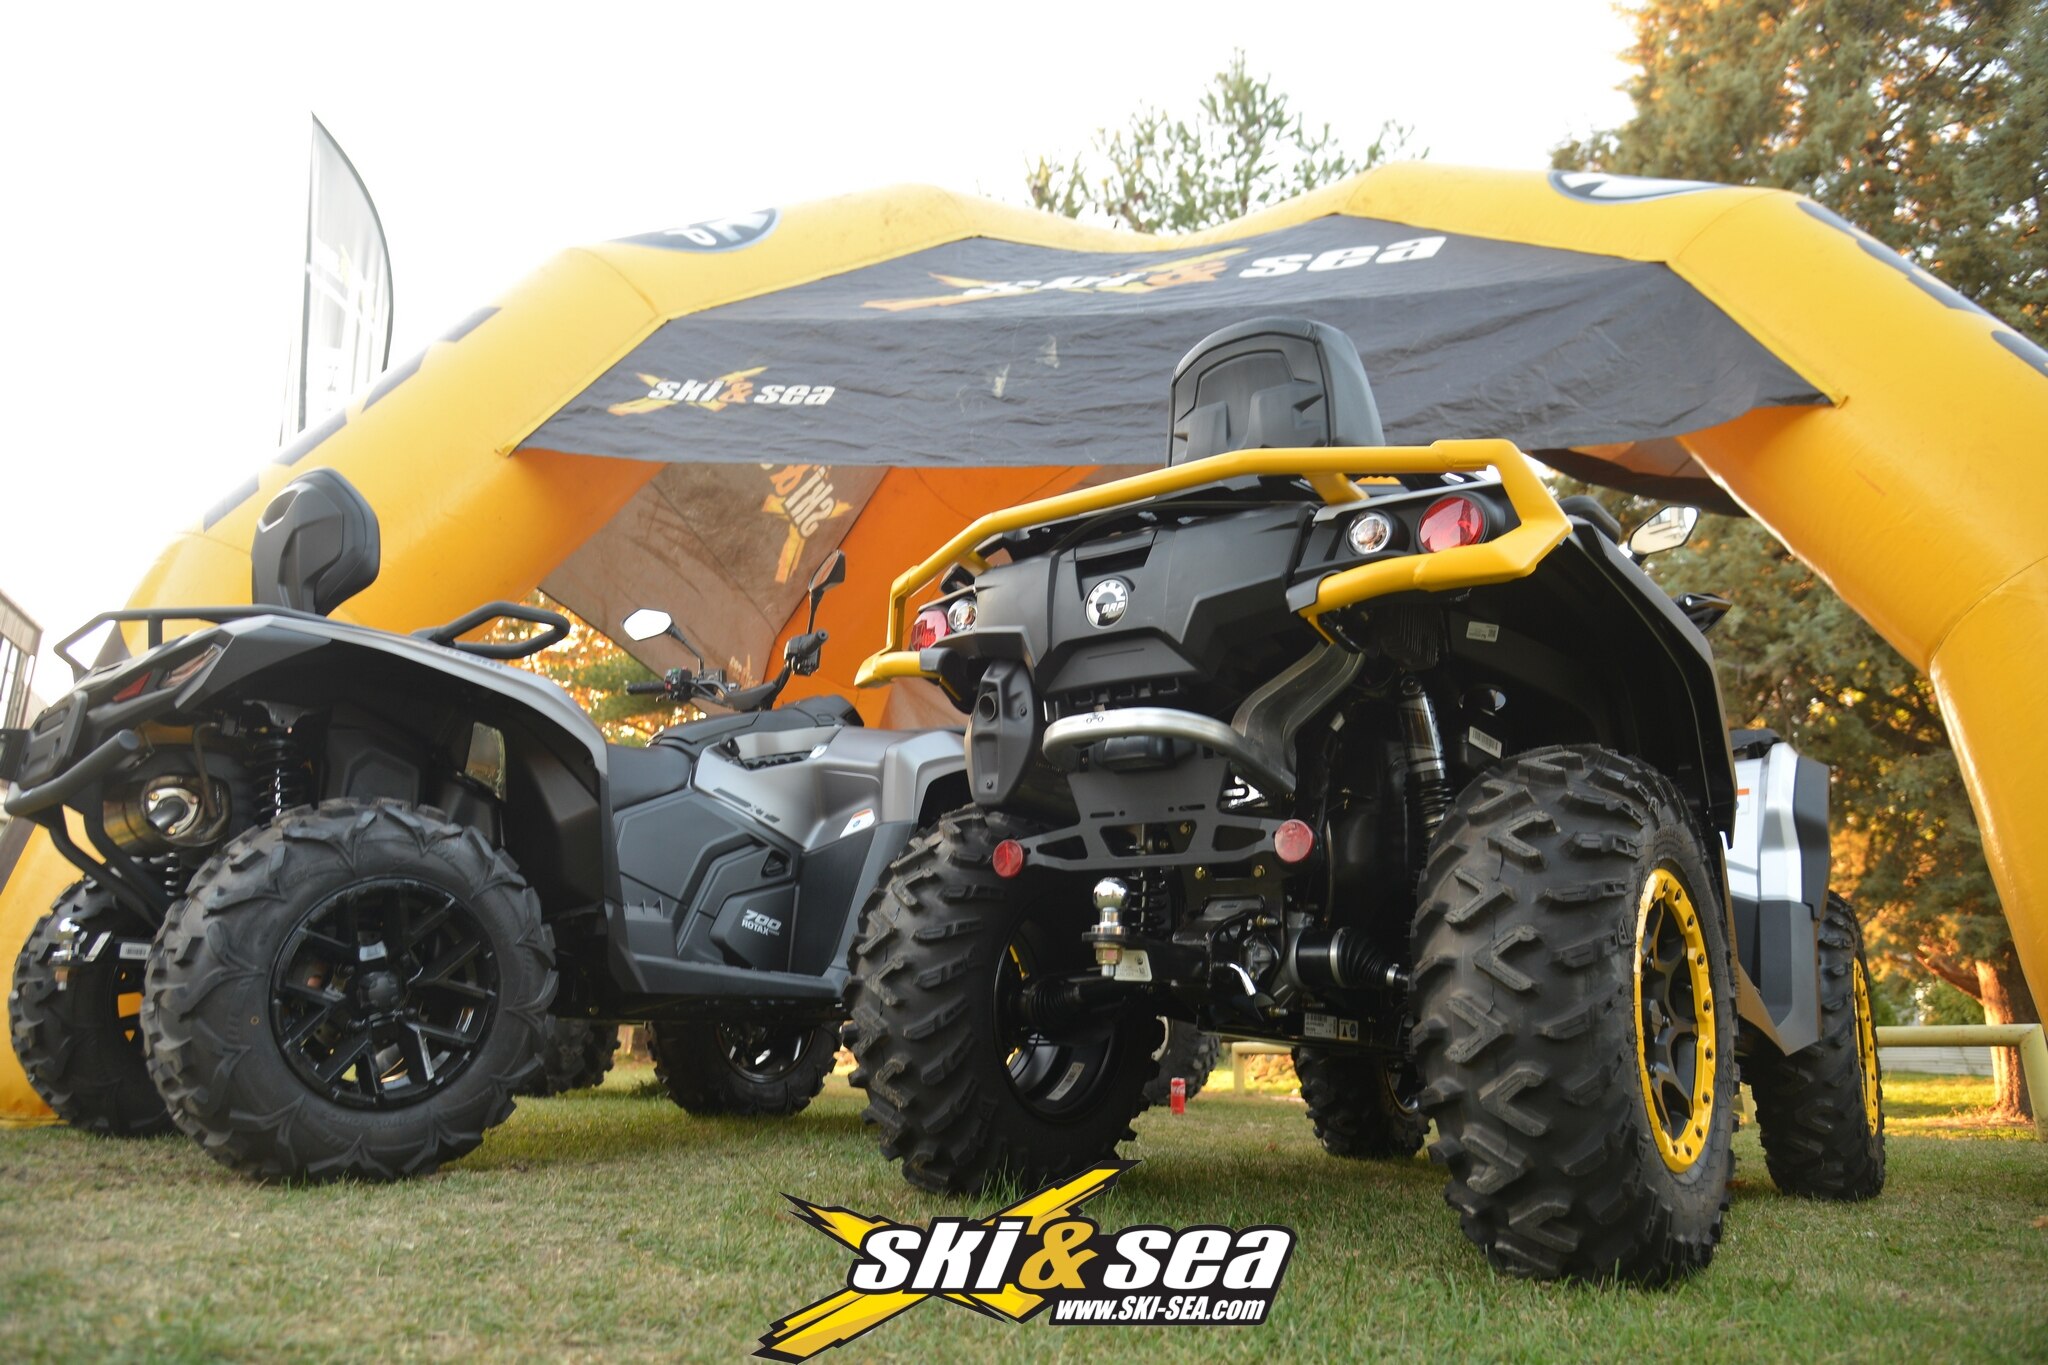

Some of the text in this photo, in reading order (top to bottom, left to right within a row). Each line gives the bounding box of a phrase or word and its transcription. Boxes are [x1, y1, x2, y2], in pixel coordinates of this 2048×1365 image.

[1239, 236, 1447, 279] sea
[754, 384, 836, 406] sea
[741, 919, 769, 936] ROTAX
[743, 909, 782, 931] 700
